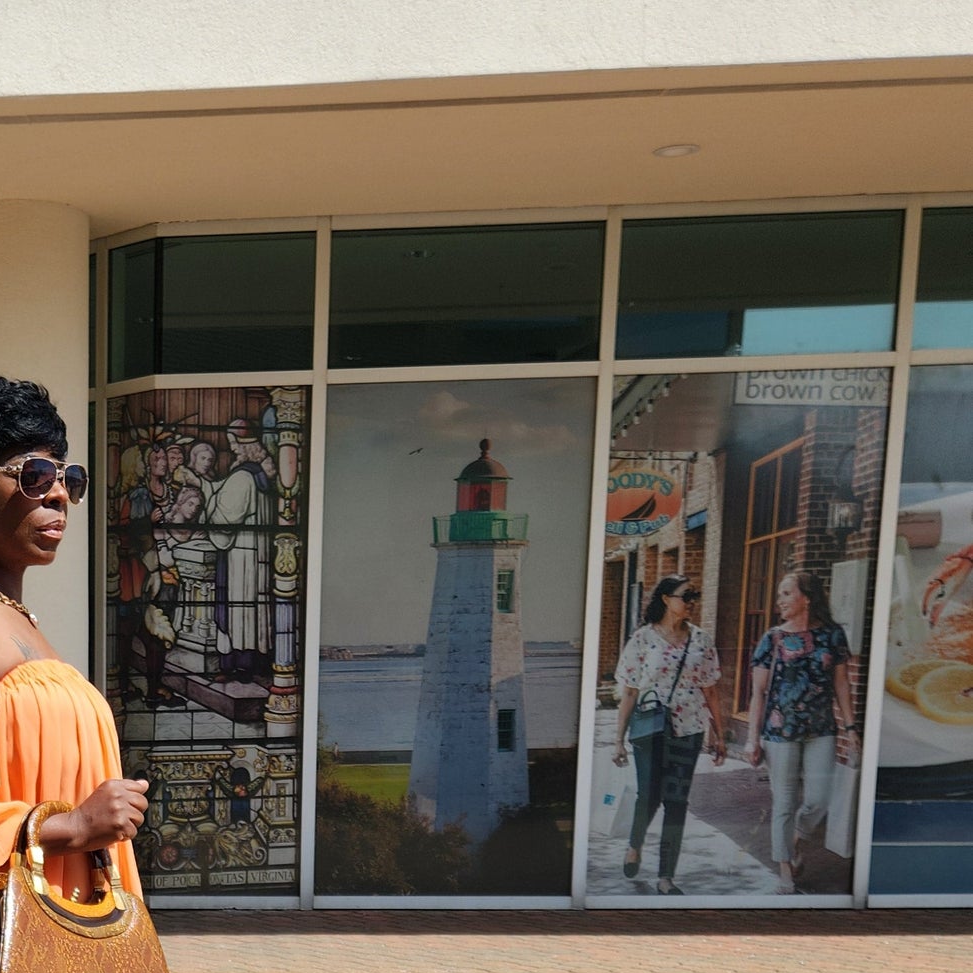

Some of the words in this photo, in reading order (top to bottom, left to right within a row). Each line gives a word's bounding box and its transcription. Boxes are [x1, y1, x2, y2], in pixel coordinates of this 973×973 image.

[745, 379, 823, 399] brown
[156, 876, 168, 887] OF
[251, 870, 296, 884] VIRGINIA
